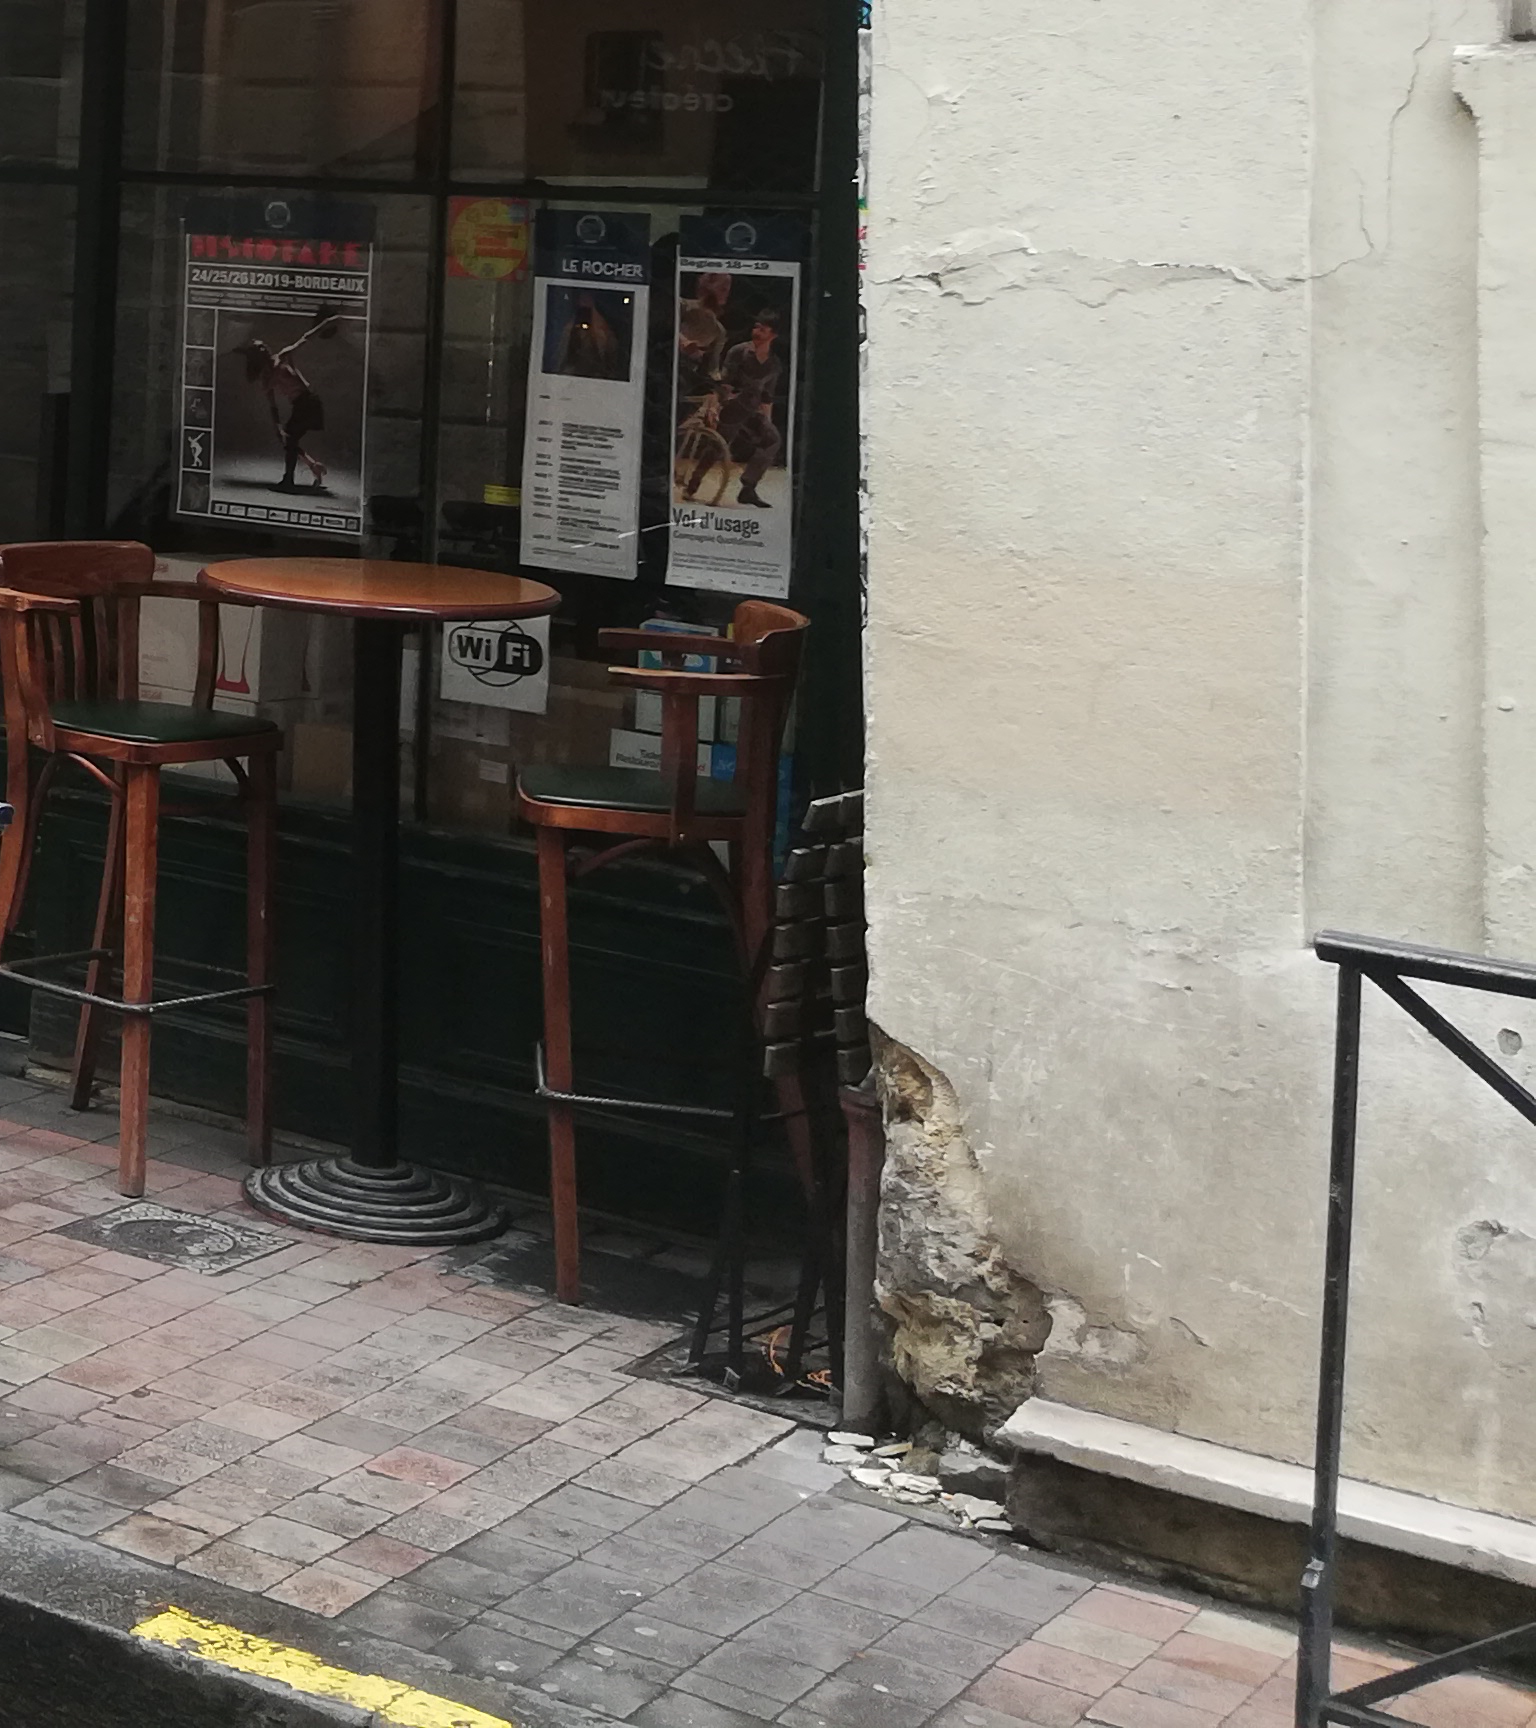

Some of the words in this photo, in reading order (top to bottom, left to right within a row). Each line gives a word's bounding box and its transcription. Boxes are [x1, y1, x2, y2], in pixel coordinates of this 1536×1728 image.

[562, 258, 579, 273] LE
[581, 260, 644, 278] ROCHER
[672, 507, 696, 529] Vol
[700, 512, 761, 538] d'usage
[457, 635, 491, 661] Wi
[506, 641, 530, 668] Fi
